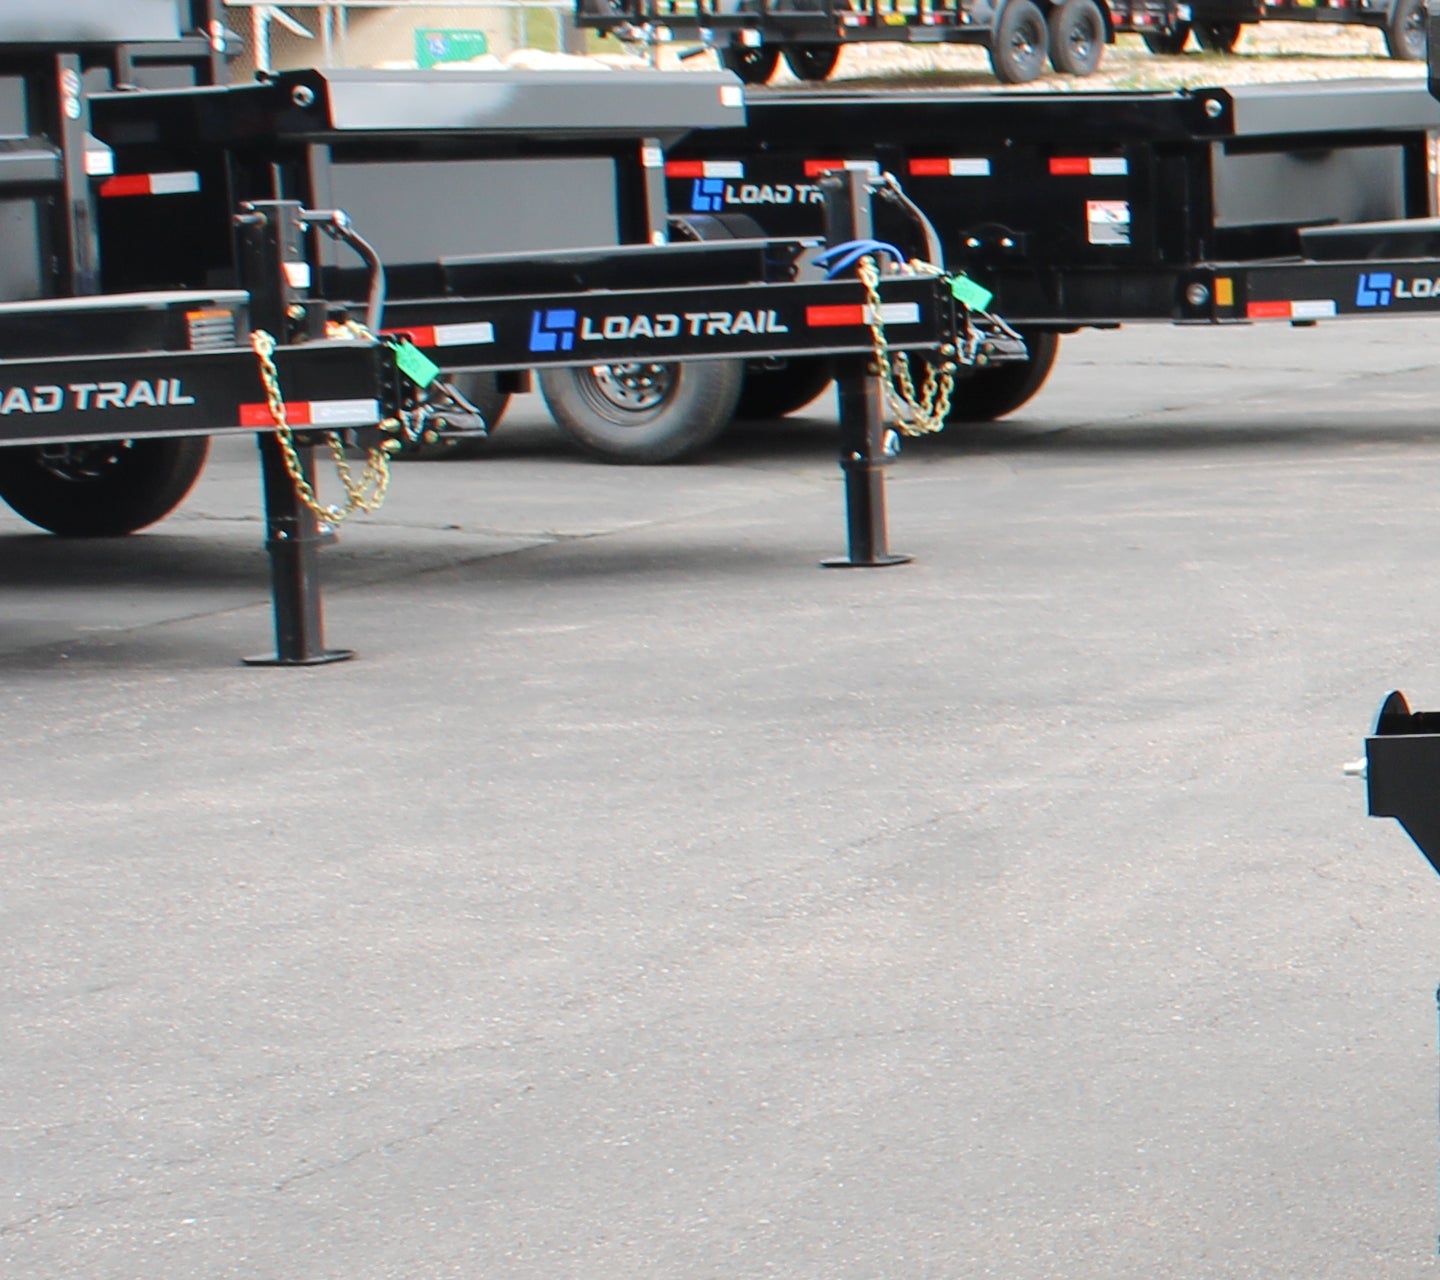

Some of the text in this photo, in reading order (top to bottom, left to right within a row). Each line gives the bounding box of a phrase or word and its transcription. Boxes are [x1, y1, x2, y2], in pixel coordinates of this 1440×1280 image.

[725, 184, 793, 204] LOAD
[580, 310, 789, 340] LOAD TRAIL
[0, 378, 196, 415] AD TRAIL
